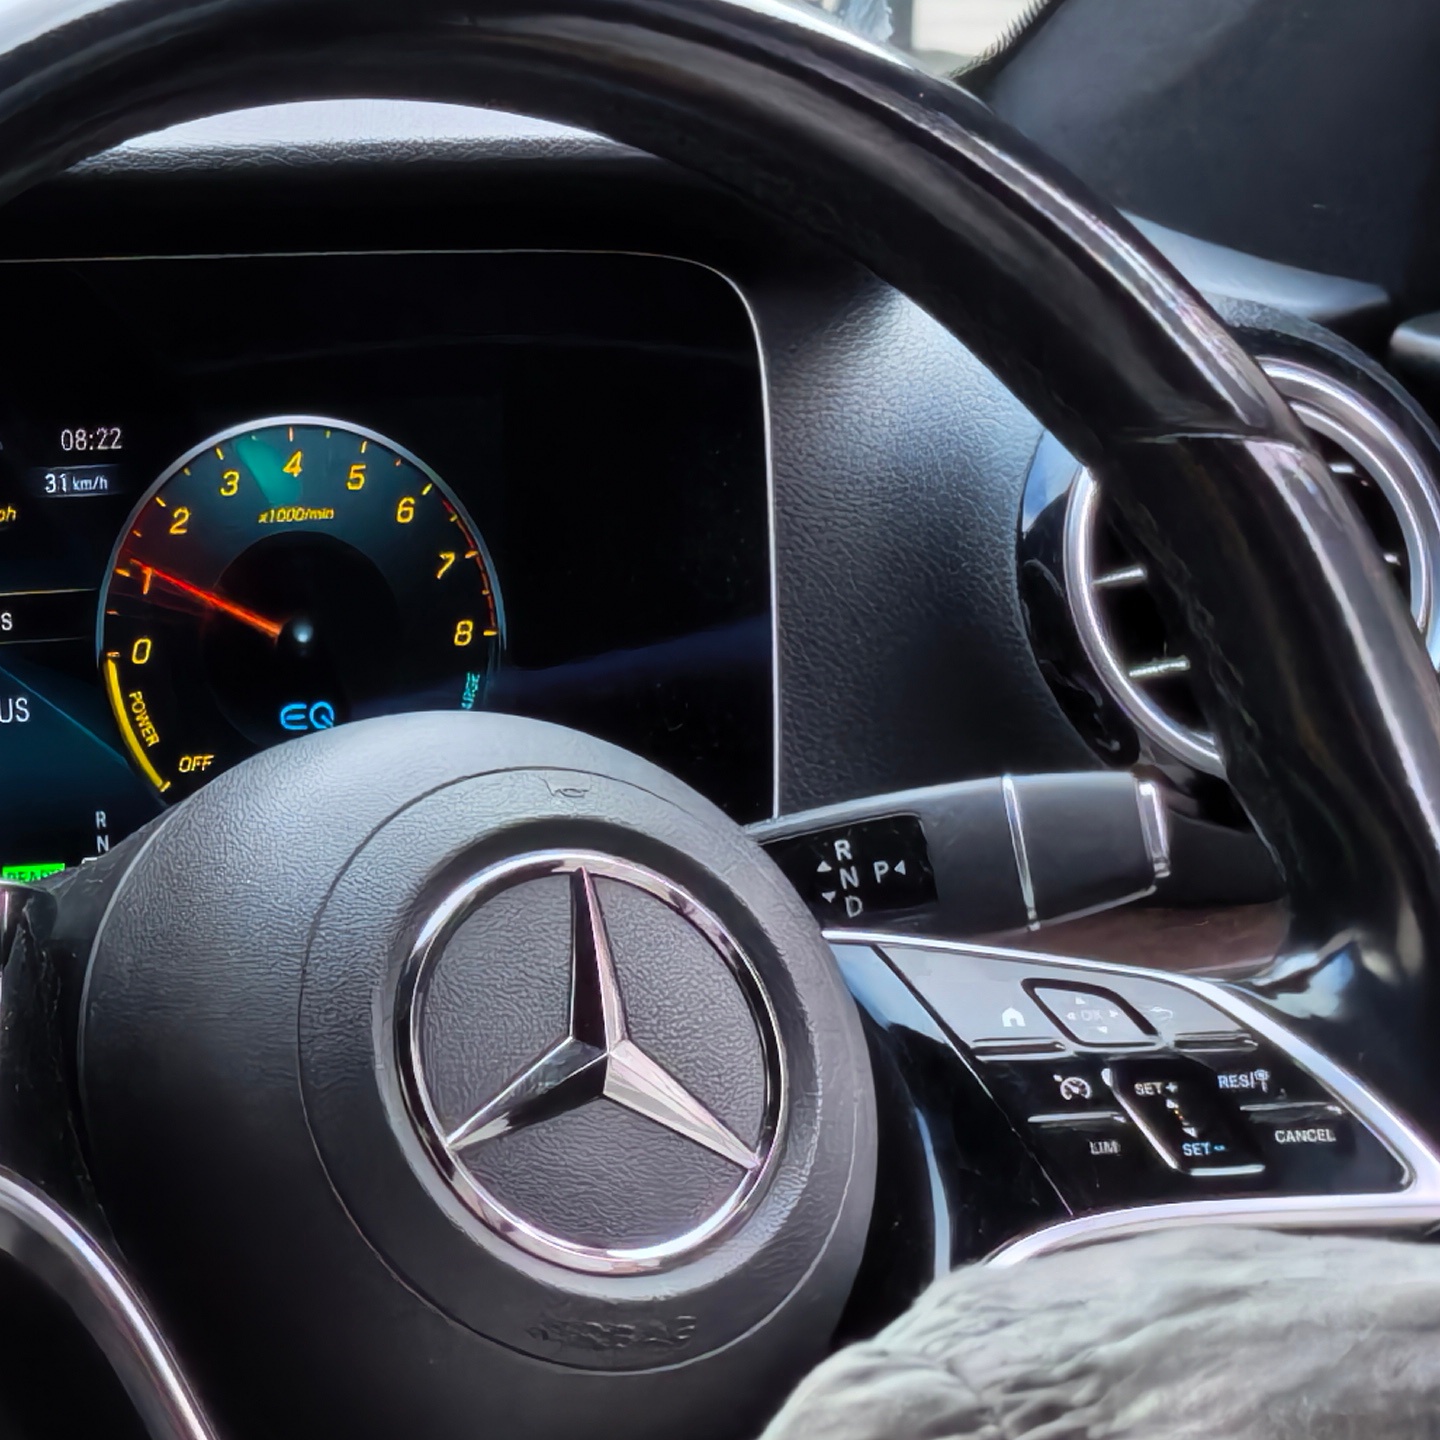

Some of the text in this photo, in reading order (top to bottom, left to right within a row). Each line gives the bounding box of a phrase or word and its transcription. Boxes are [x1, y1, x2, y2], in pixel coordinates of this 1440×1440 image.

[60, 427, 122, 452] 08:22
[282, 450, 303, 478] 4
[346, 464, 366, 490] 5
[45, 472, 108, 494] 31 km/h
[221, 471, 240, 496] 3
[169, 507, 191, 535] 2
[396, 497, 415, 523] 6
[436, 552, 456, 580] 7
[142, 566, 154, 595] 1
[454, 620, 474, 646] 8
[132, 638, 152, 665] 0
[129, 690, 161, 748] POWER
[279, 701, 335, 730] EQ
[178, 754, 215, 773] OFF
[95, 810, 107, 829] R
[96, 834, 109, 853] N
[834, 839, 853, 861] R
[839, 860, 890, 890] N P
[845, 895, 863, 918] D
[1274, 1128, 1336, 1145] CANCEL
